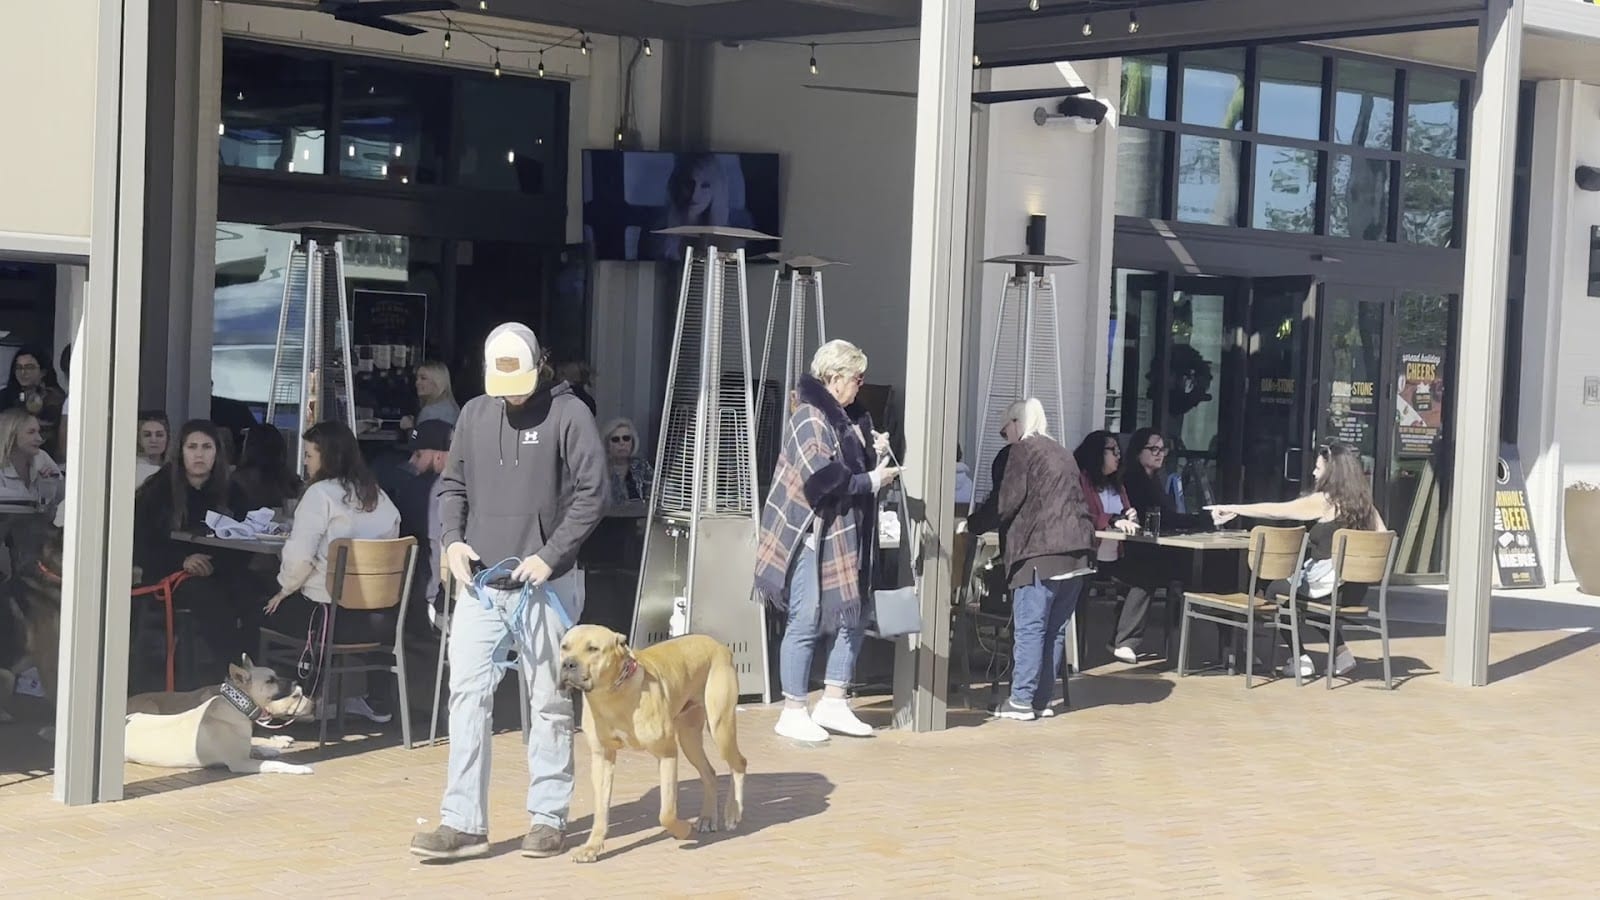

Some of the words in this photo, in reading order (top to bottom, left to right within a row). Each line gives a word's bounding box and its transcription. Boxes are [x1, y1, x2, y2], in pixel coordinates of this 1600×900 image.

[1406, 363, 1436, 381] CHEERS
[1352, 382, 1374, 396] STONE
[1501, 508, 1530, 531] BEER
